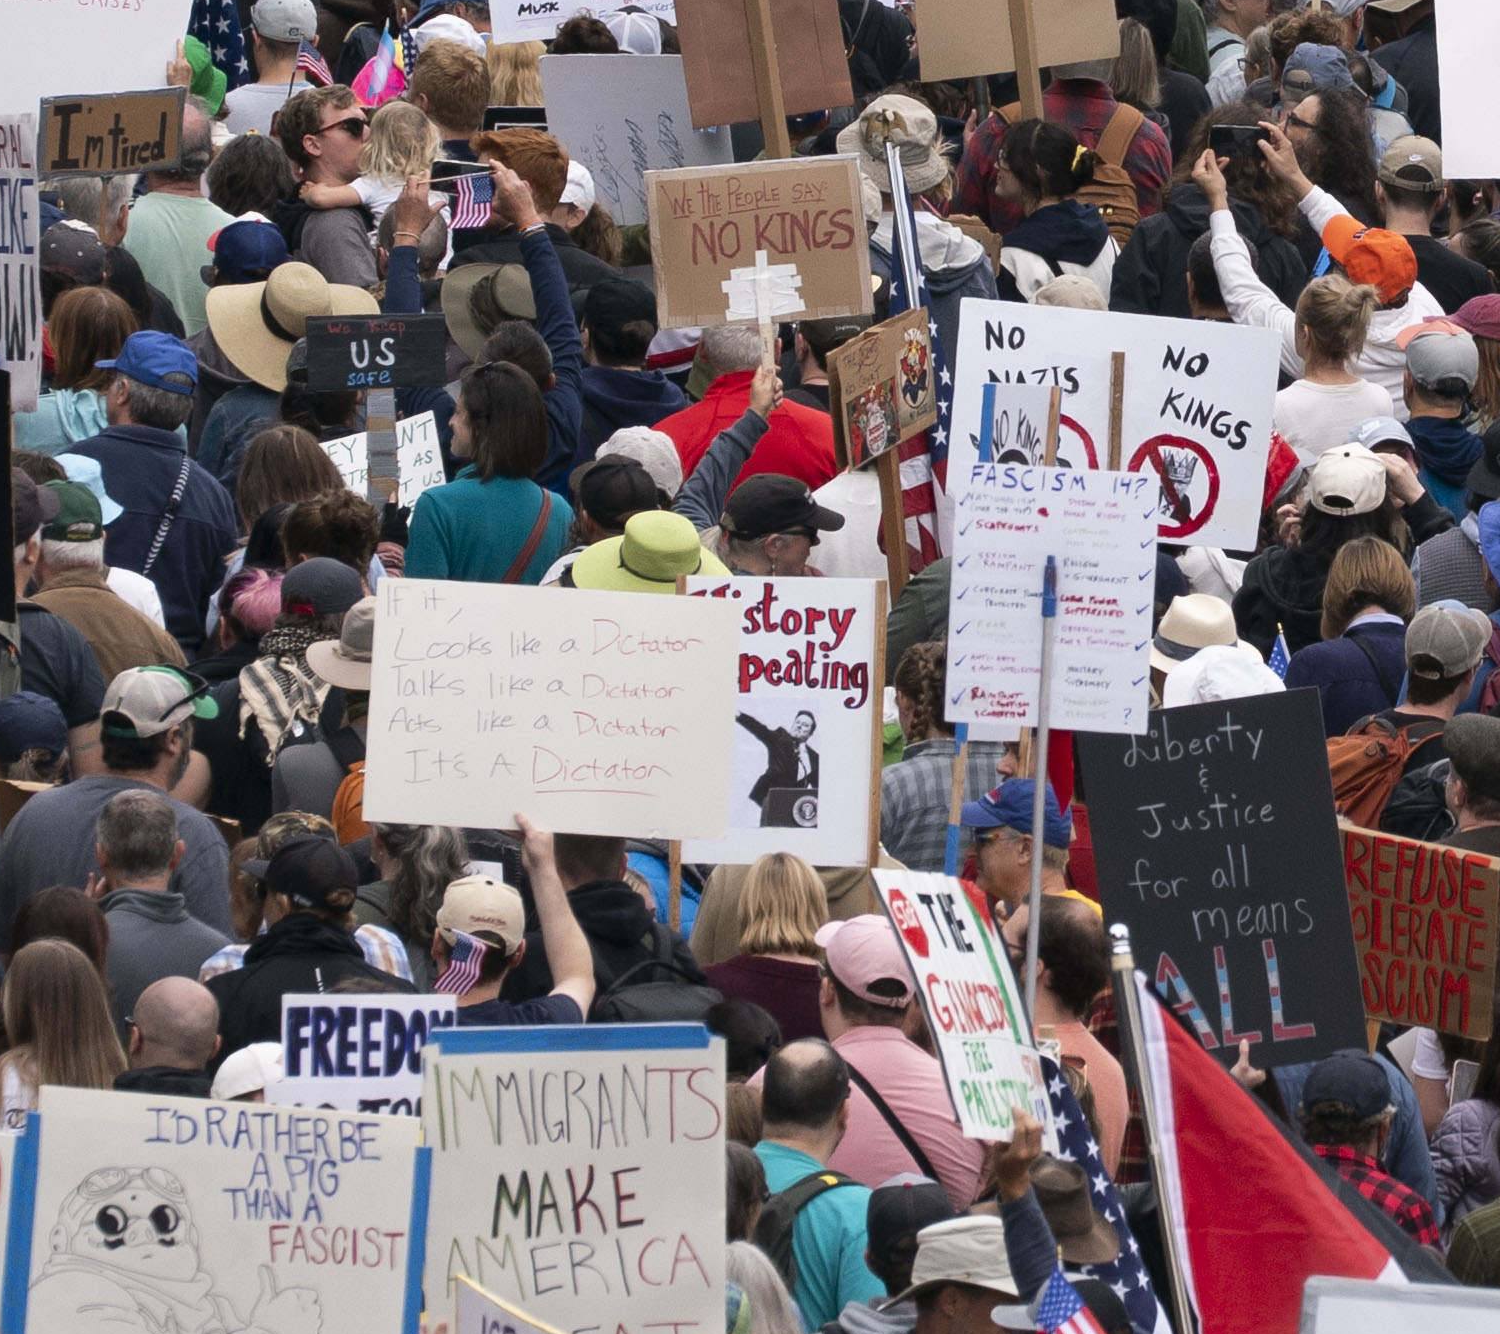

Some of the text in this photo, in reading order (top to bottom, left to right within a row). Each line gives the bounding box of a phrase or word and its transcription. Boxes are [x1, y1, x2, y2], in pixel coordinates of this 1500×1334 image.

[518, 2, 559, 16] MUSK
[50, 104, 169, 169] I'm tired
[1160, 389, 1253, 451] KINGS
[1125, 711, 1264, 767] Liberty
[431, 1064, 722, 1151] IMMIGRANTS
[268, 1223, 405, 1269] FASCIST
